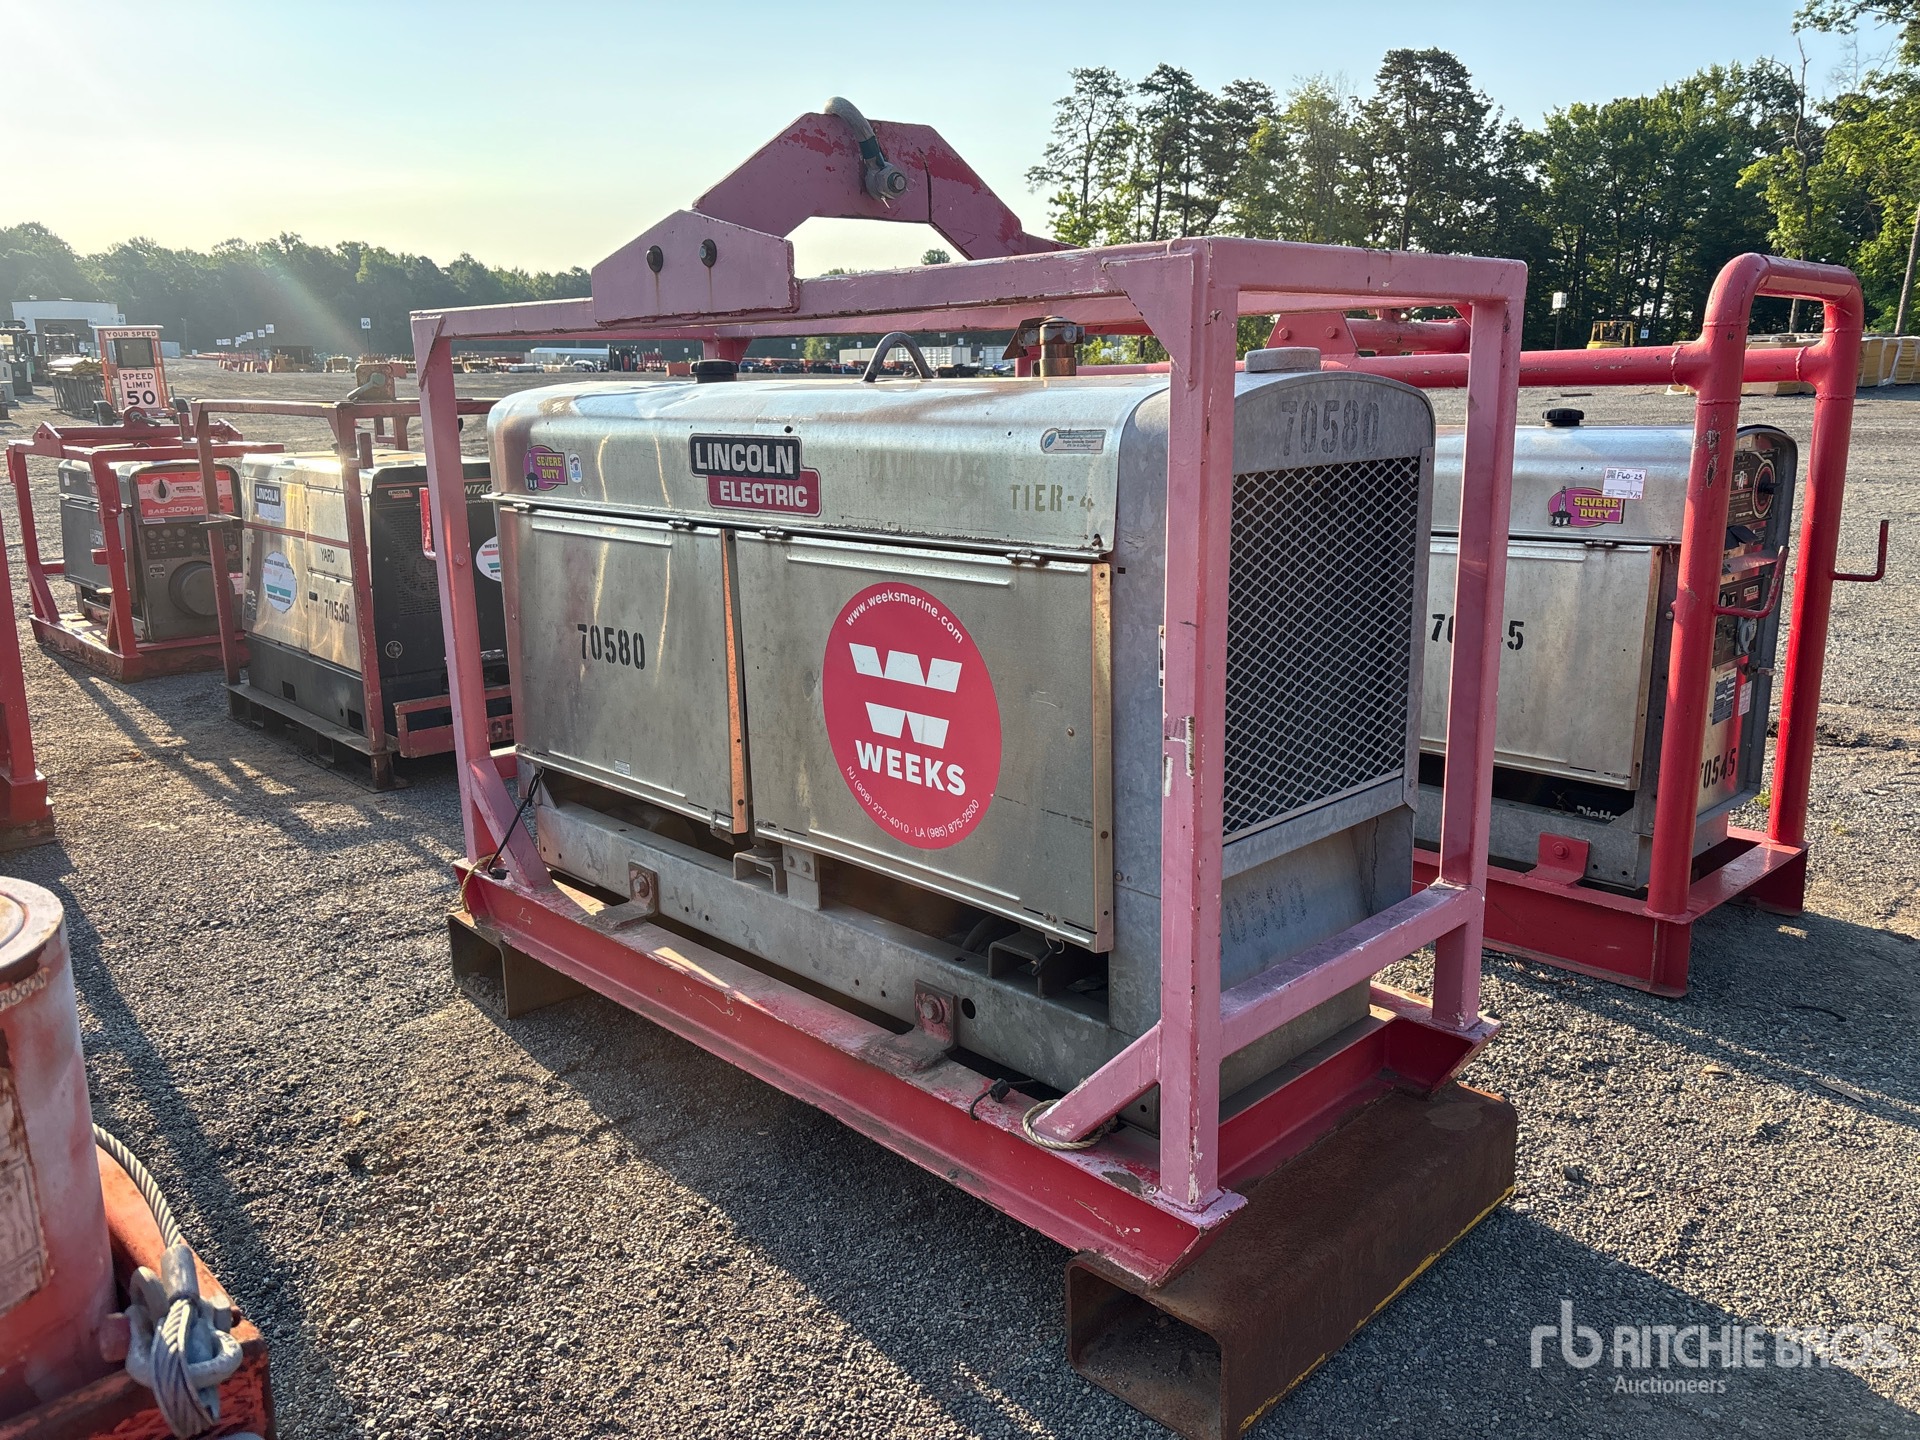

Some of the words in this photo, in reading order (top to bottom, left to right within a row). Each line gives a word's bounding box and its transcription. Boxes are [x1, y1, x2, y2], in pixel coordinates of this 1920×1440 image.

[126, 390, 156, 405] 50
[1281, 399, 1380, 456] 70580
[536, 456, 563, 467] SEVERE
[695, 442, 794, 475] LINCOLN
[541, 468, 560, 479] DUTY
[255, 486, 280, 503] LINCOLN
[719, 480, 808, 508] ELECTRIC
[1573, 496, 1619, 508] SEVERE
[148, 506, 189, 515] SAE-300
[1580, 508, 1611, 518] DUTY
[320, 547, 335, 563] YARD
[324, 599, 350, 624] 70536
[846, 589, 964, 644] www.weeksmarine.com
[577, 623, 646, 670] 70580
[855, 739, 966, 796] WEEKS
[846, 766, 857, 780] NJ
[854, 779, 873, 806] (908)
[872, 803, 910, 834] 272-4010
[914, 827, 926, 837] LA
[926, 824, 948, 840] (985)
[947, 799, 980, 834] 875-2500
